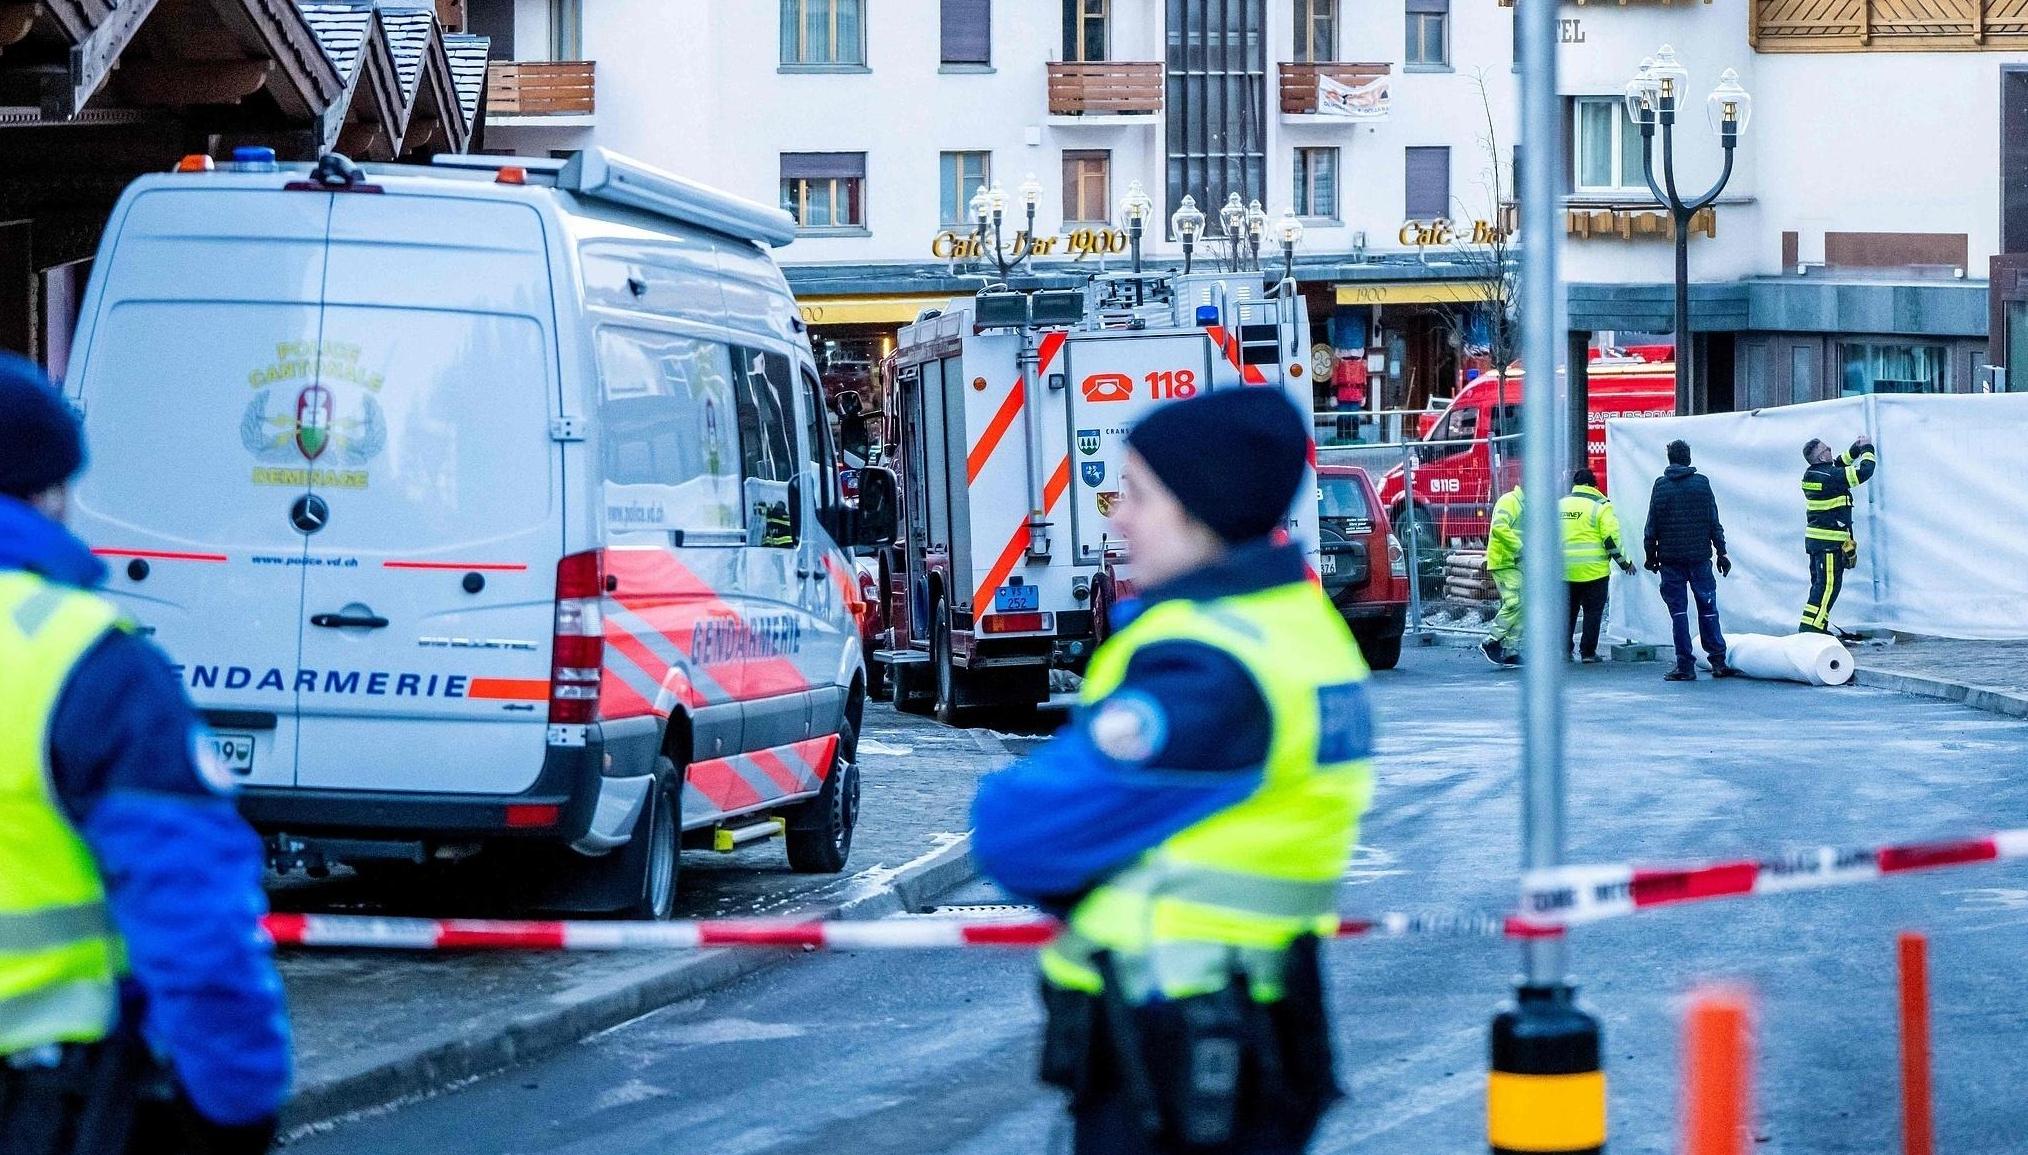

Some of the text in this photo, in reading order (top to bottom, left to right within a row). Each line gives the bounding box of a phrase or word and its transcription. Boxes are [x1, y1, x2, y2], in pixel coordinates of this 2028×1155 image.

[1063, 228, 1127, 262] 1900
[1357, 287, 1387, 302] 1900
[1145, 370, 1196, 400] 118
[251, 556, 358, 567] www.police.vd.ch
[1008, 597, 1027, 608] 252
[691, 614, 800, 666] GENDARMERIE
[171, 664, 467, 698] ENDARMERIE
